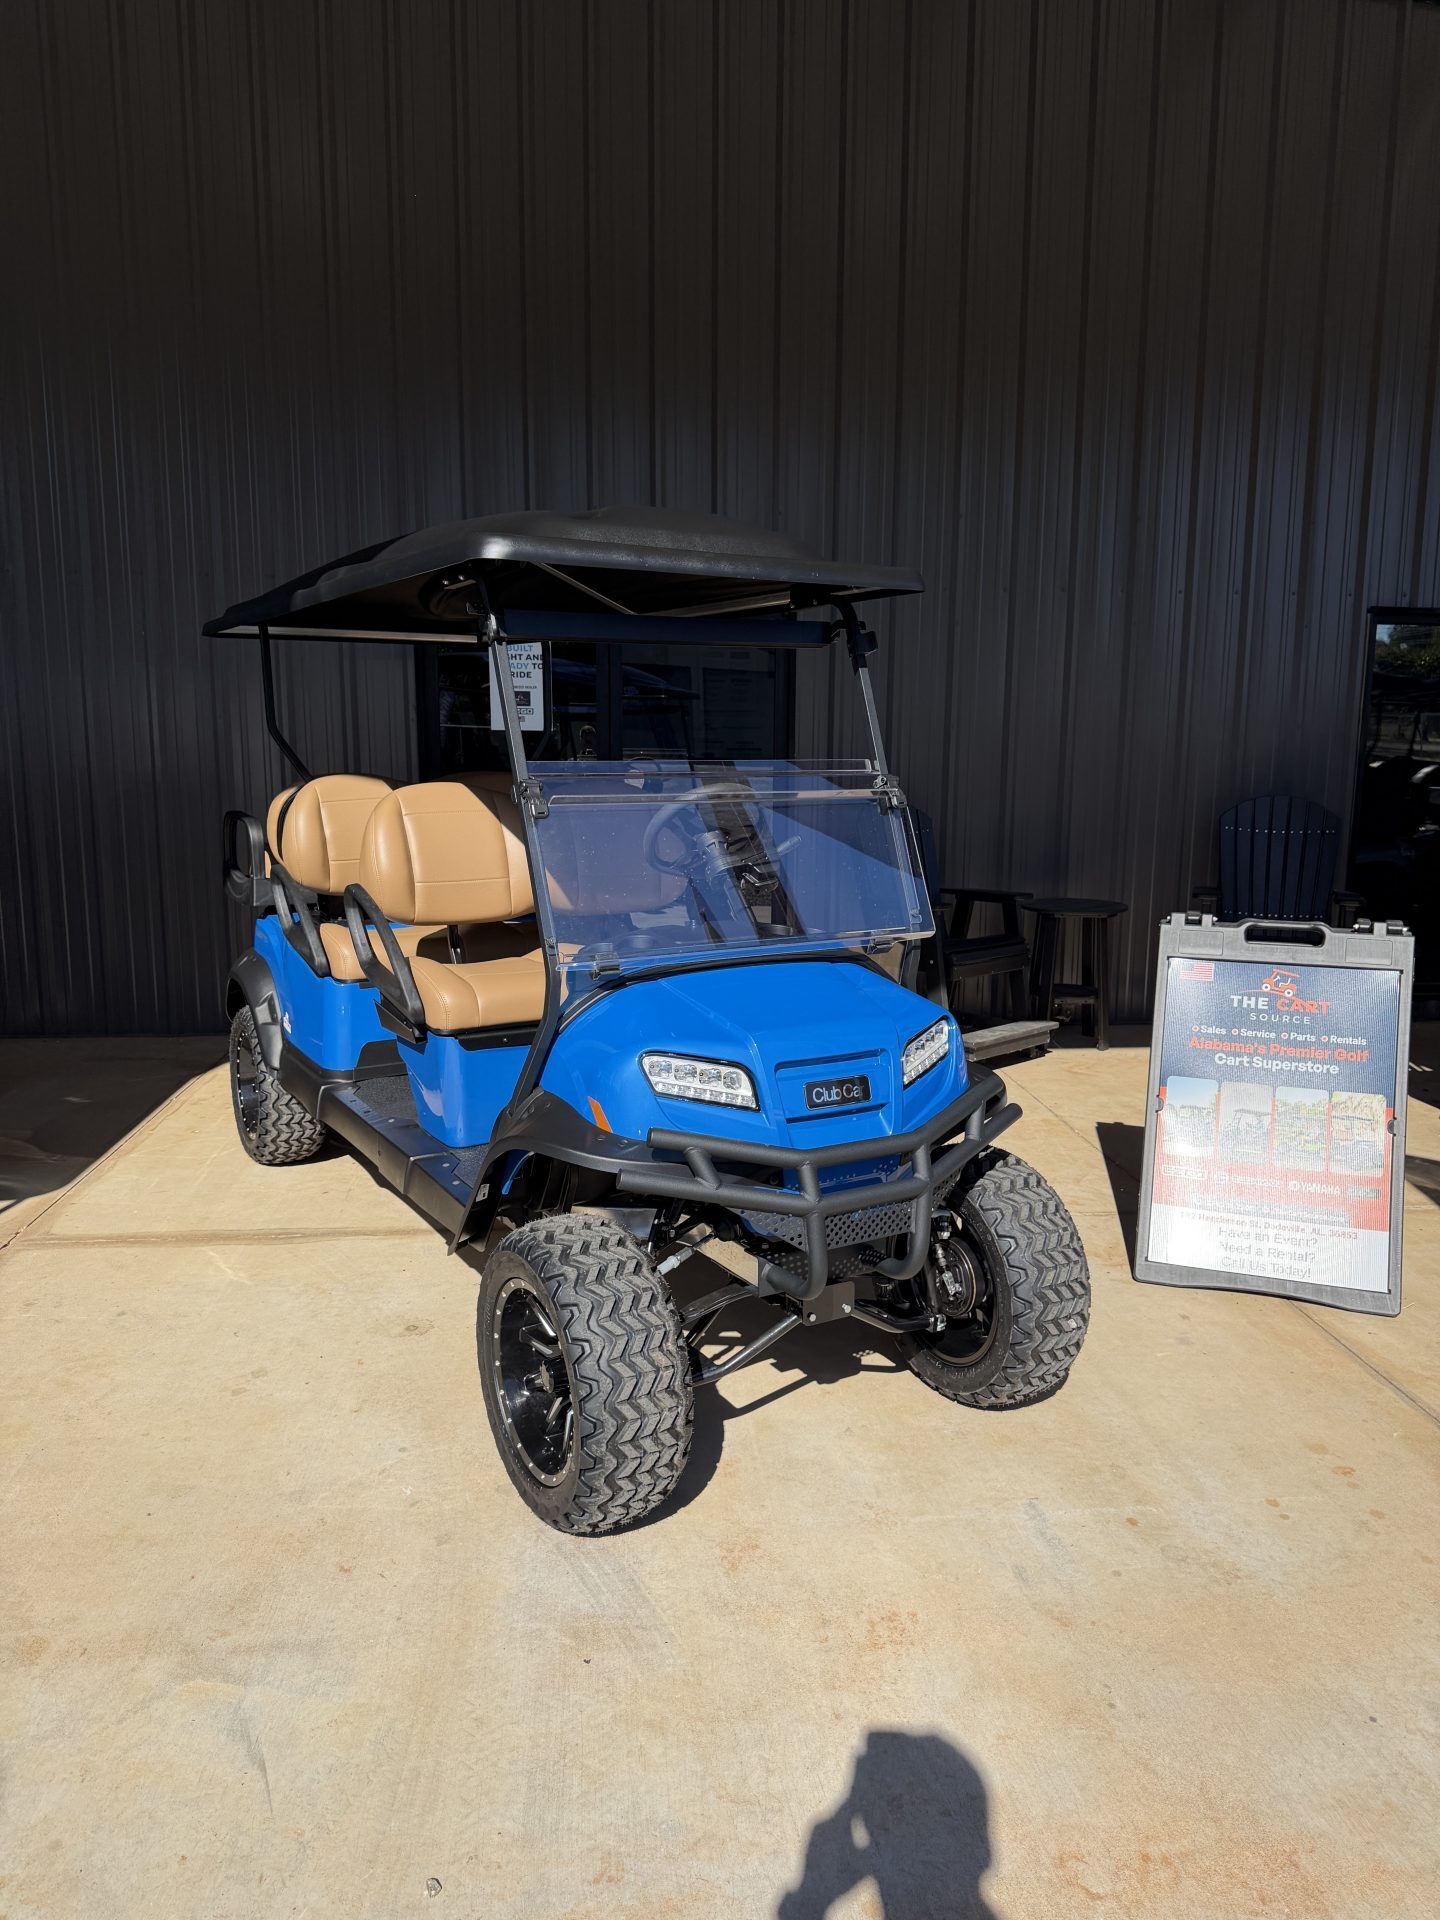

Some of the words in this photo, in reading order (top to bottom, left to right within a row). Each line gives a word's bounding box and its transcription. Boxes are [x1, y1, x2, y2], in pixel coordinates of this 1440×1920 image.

[511, 671, 532, 679] RIDE
[1230, 994, 1269, 1010] THE
[1276, 999, 1330, 1016] CART
[1249, 1012, 1311, 1025] SOURCE
[1200, 1025, 1227, 1035] Sales
[1240, 1029, 1276, 1039] Service
[1290, 1032, 1316, 1042] Parts
[1330, 1035, 1367, 1046] Rentals
[1189, 1037, 1267, 1055] Alabama's
[1269, 1043, 1331, 1060] Premier
[1334, 1048, 1369, 1063] Golf
[1214, 1053, 1250, 1067] Cart
[1252, 1056, 1340, 1075] Superstore
[812, 1085, 842, 1103] Club
[842, 1083, 864, 1098] Car
[1301, 1181, 1341, 1195] YAMAHA
[1219, 1226, 1250, 1240] Have
[1255, 1232, 1269, 1243] an
[1274, 1232, 1317, 1248] Event?
[1219, 1240, 1251, 1255] Need
[1255, 1248, 1263, 1257] a
[1268, 1247, 1316, 1263] Rental?
[1221, 1256, 1245, 1269] Call
[1250, 1260, 1266, 1272] Us
[1270, 1262, 1311, 1279] Today!
